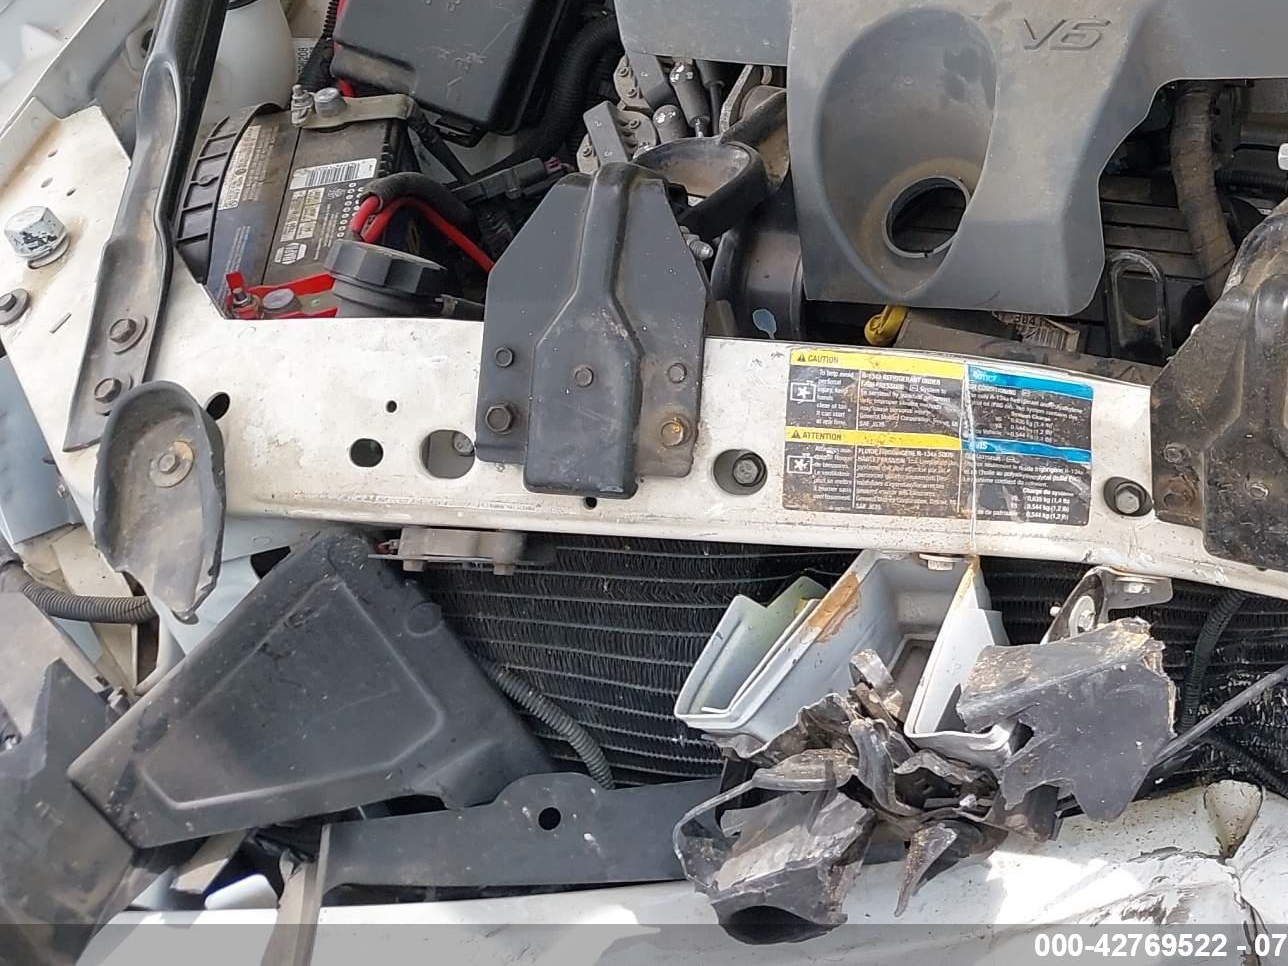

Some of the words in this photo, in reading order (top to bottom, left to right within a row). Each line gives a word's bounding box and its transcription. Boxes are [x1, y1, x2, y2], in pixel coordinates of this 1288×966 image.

[1023, 16, 1112, 51] V6
[807, 354, 838, 364] CAUTION
[802, 430, 842, 442] ATTENTION
